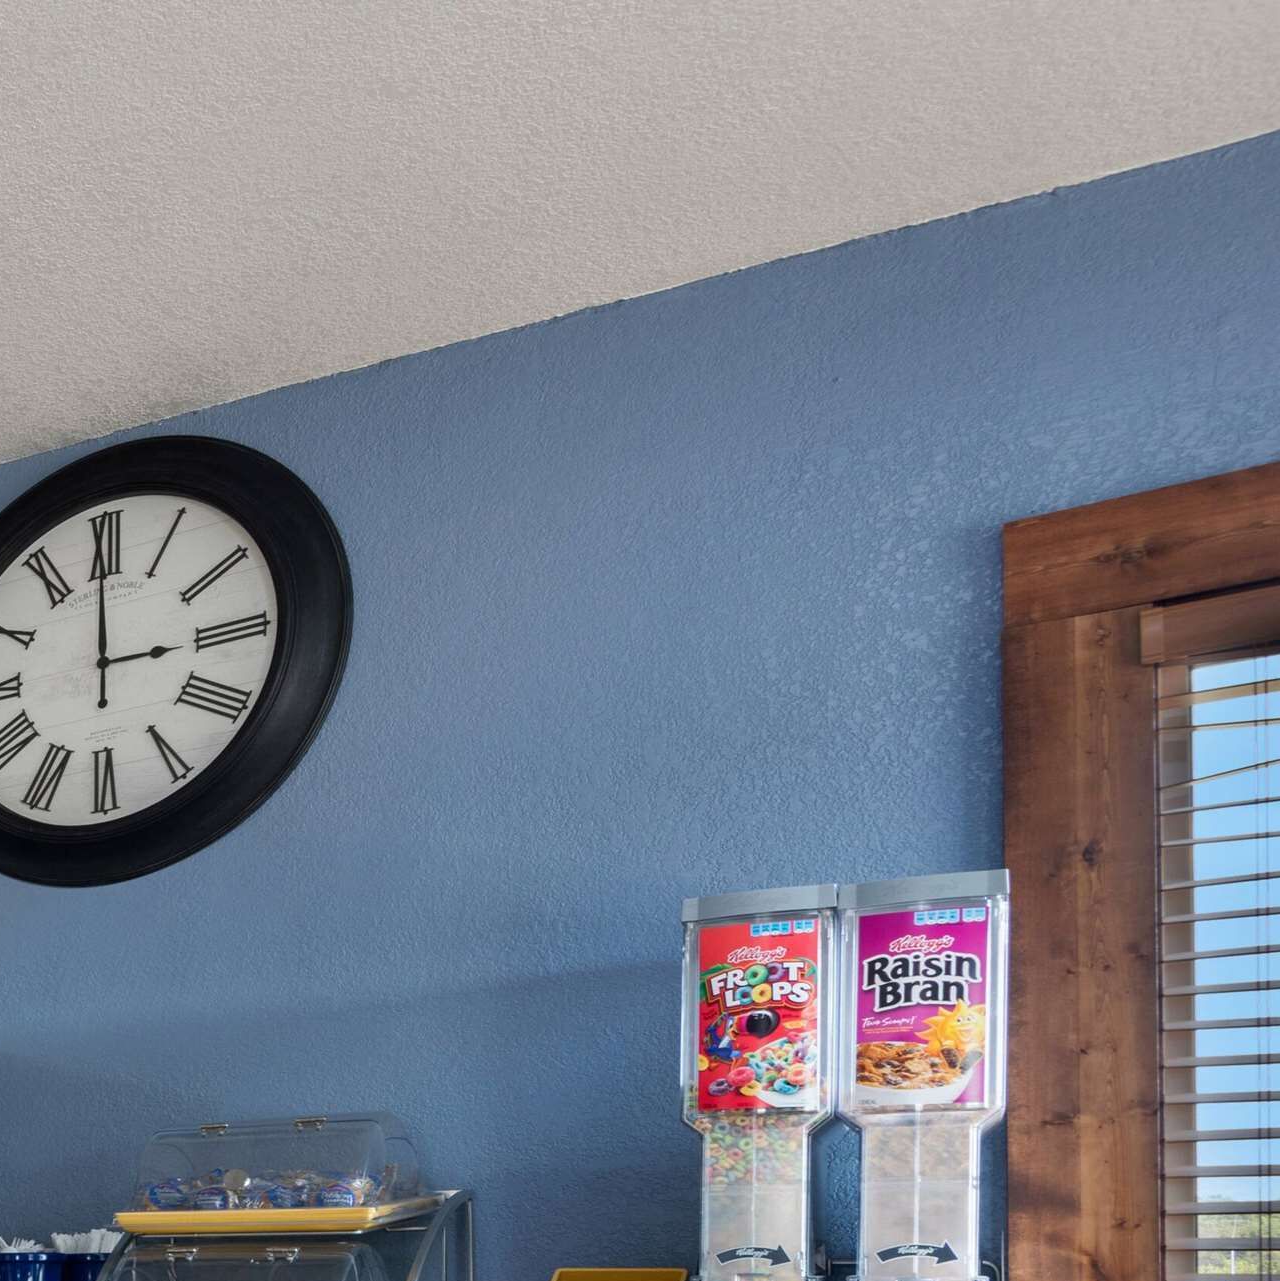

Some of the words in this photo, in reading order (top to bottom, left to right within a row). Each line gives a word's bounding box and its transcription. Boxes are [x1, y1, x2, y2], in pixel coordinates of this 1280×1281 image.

[146, 507, 186, 578] I
[21, 546, 74, 609] XI
[179, 545, 248, 605] II
[194, 611, 270, 652] III
[146, 724, 194, 784] V
[91, 746, 120, 815] VI
[729, 947, 787, 963] Kellogg's
[890, 935, 954, 951] Kellogg's
[710, 961, 804, 996] FROOT
[865, 953, 978, 987] Raisin
[724, 982, 812, 1008] LOOPS
[877, 980, 965, 1010] Bran
